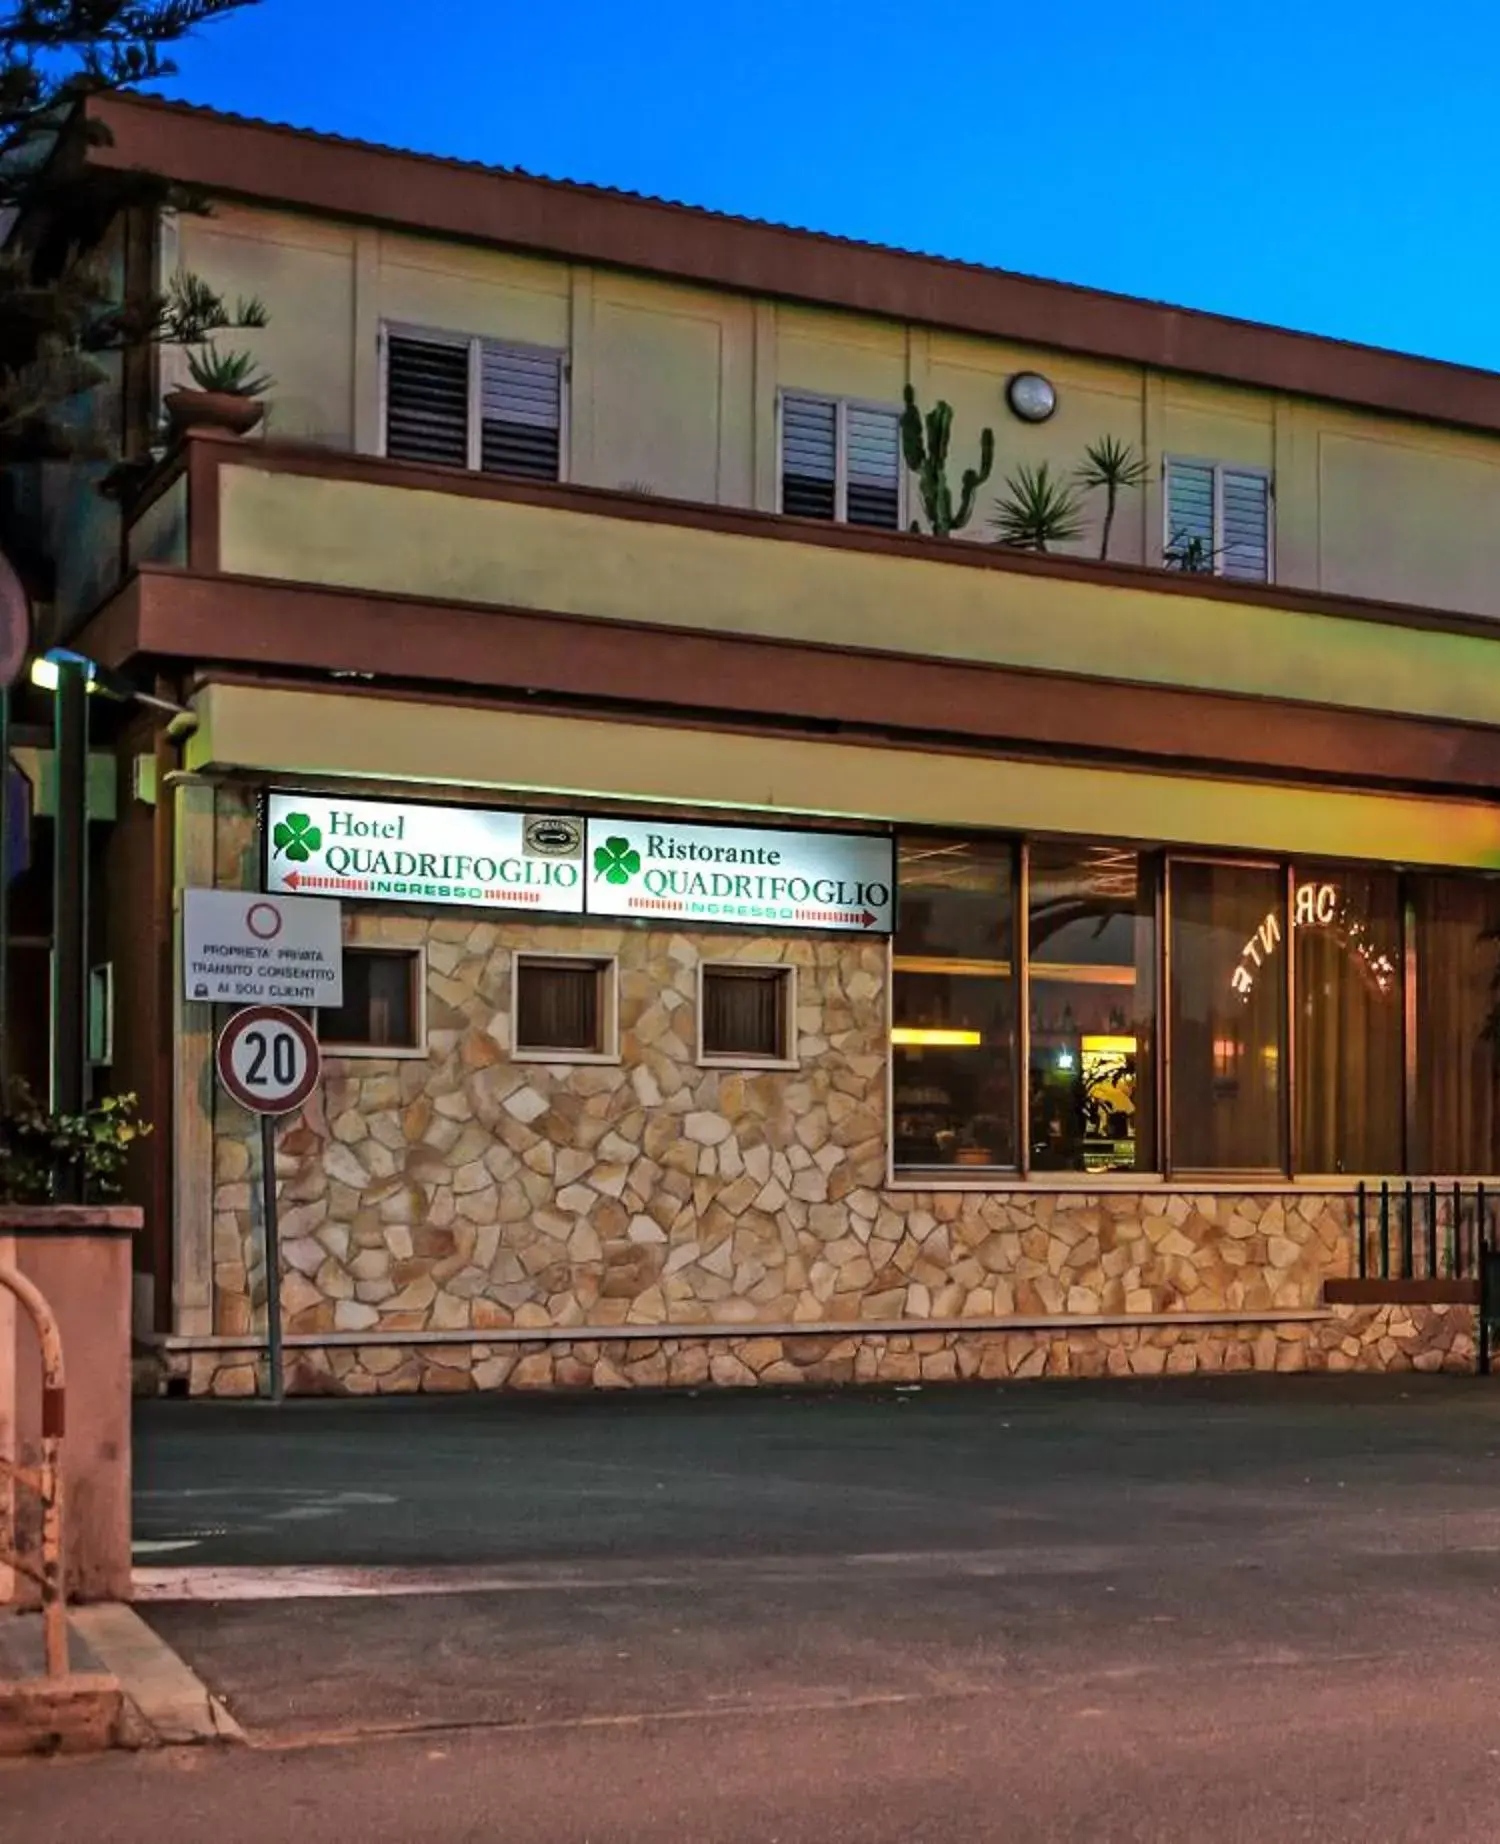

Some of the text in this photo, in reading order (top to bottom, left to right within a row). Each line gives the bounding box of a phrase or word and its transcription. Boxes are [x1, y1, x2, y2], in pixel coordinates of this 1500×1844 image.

[328, 811, 405, 840] Hotel
[645, 833, 781, 865] Ristorante
[325, 845, 578, 887] QUADRIFOGLIO
[370, 881, 483, 899] INGRESSO
[643, 868, 889, 907] QUADRIFOGLIO
[685, 899, 793, 919] INGRESSO
[277, 949, 324, 962] PRIVATA
[192, 962, 335, 980] TRANSITO CONSENTITO
[217, 983, 315, 998] AI SOLI CLIENTI
[245, 1031, 296, 1086] 20
